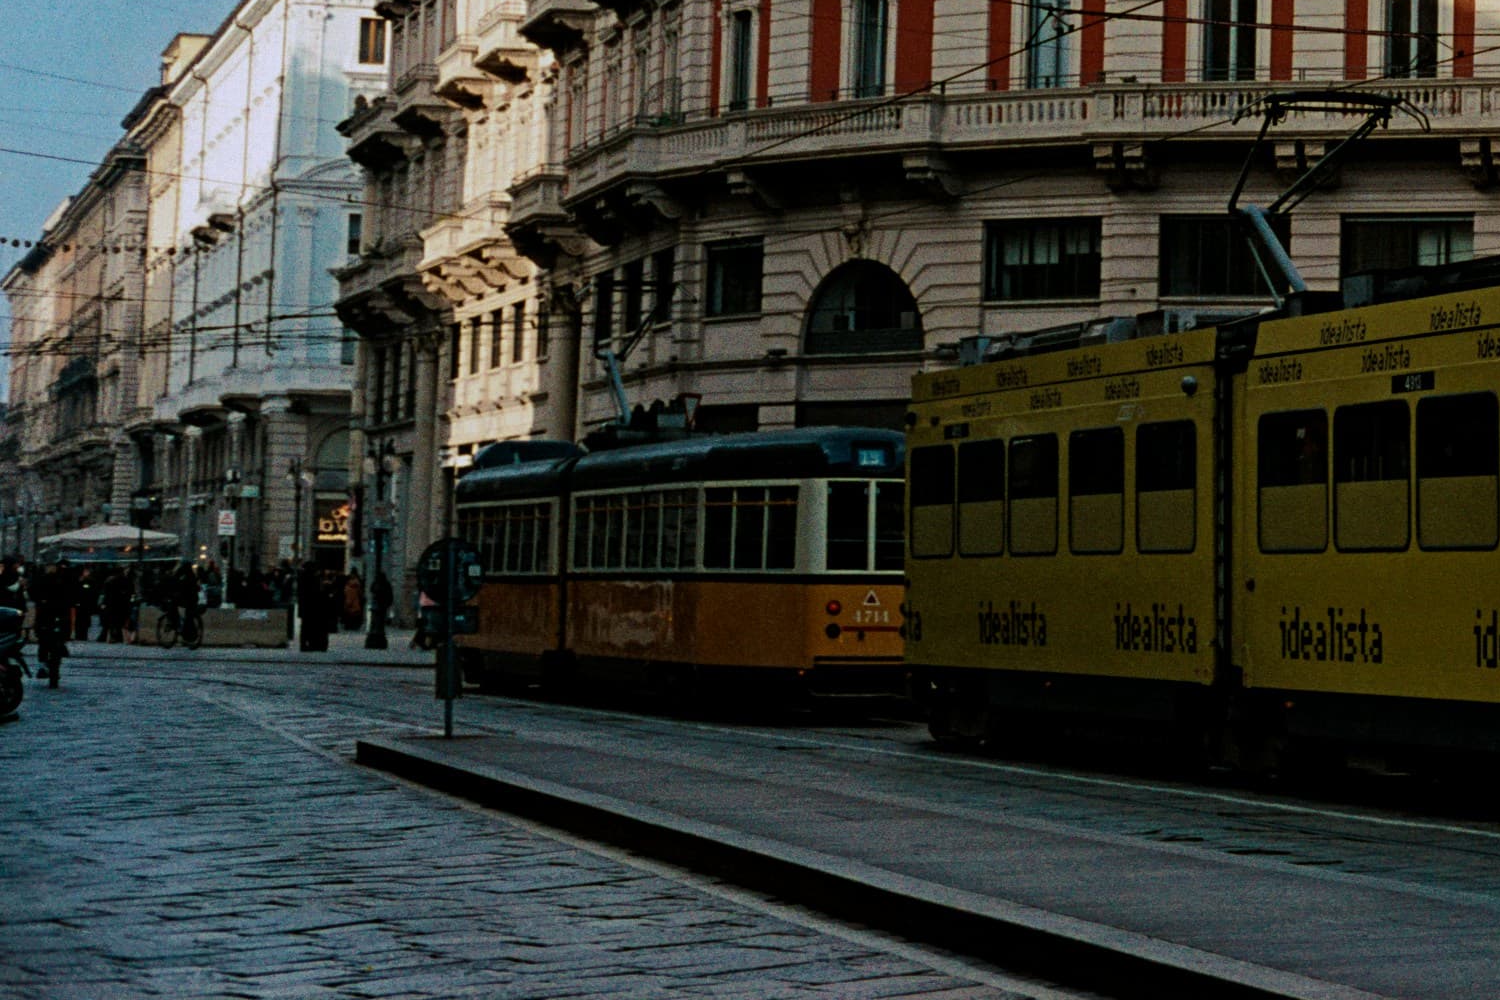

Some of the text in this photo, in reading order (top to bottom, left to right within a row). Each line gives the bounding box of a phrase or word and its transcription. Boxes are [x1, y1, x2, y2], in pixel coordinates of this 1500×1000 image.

[1319, 316, 1367, 345] idealista
[1429, 299, 1481, 331] idealista
[1258, 357, 1304, 384] idealista
[1360, 343, 1411, 373] idealista
[978, 601, 1048, 647] idealista
[1114, 602, 1197, 653] idealista
[1279, 606, 1384, 664] idealista
